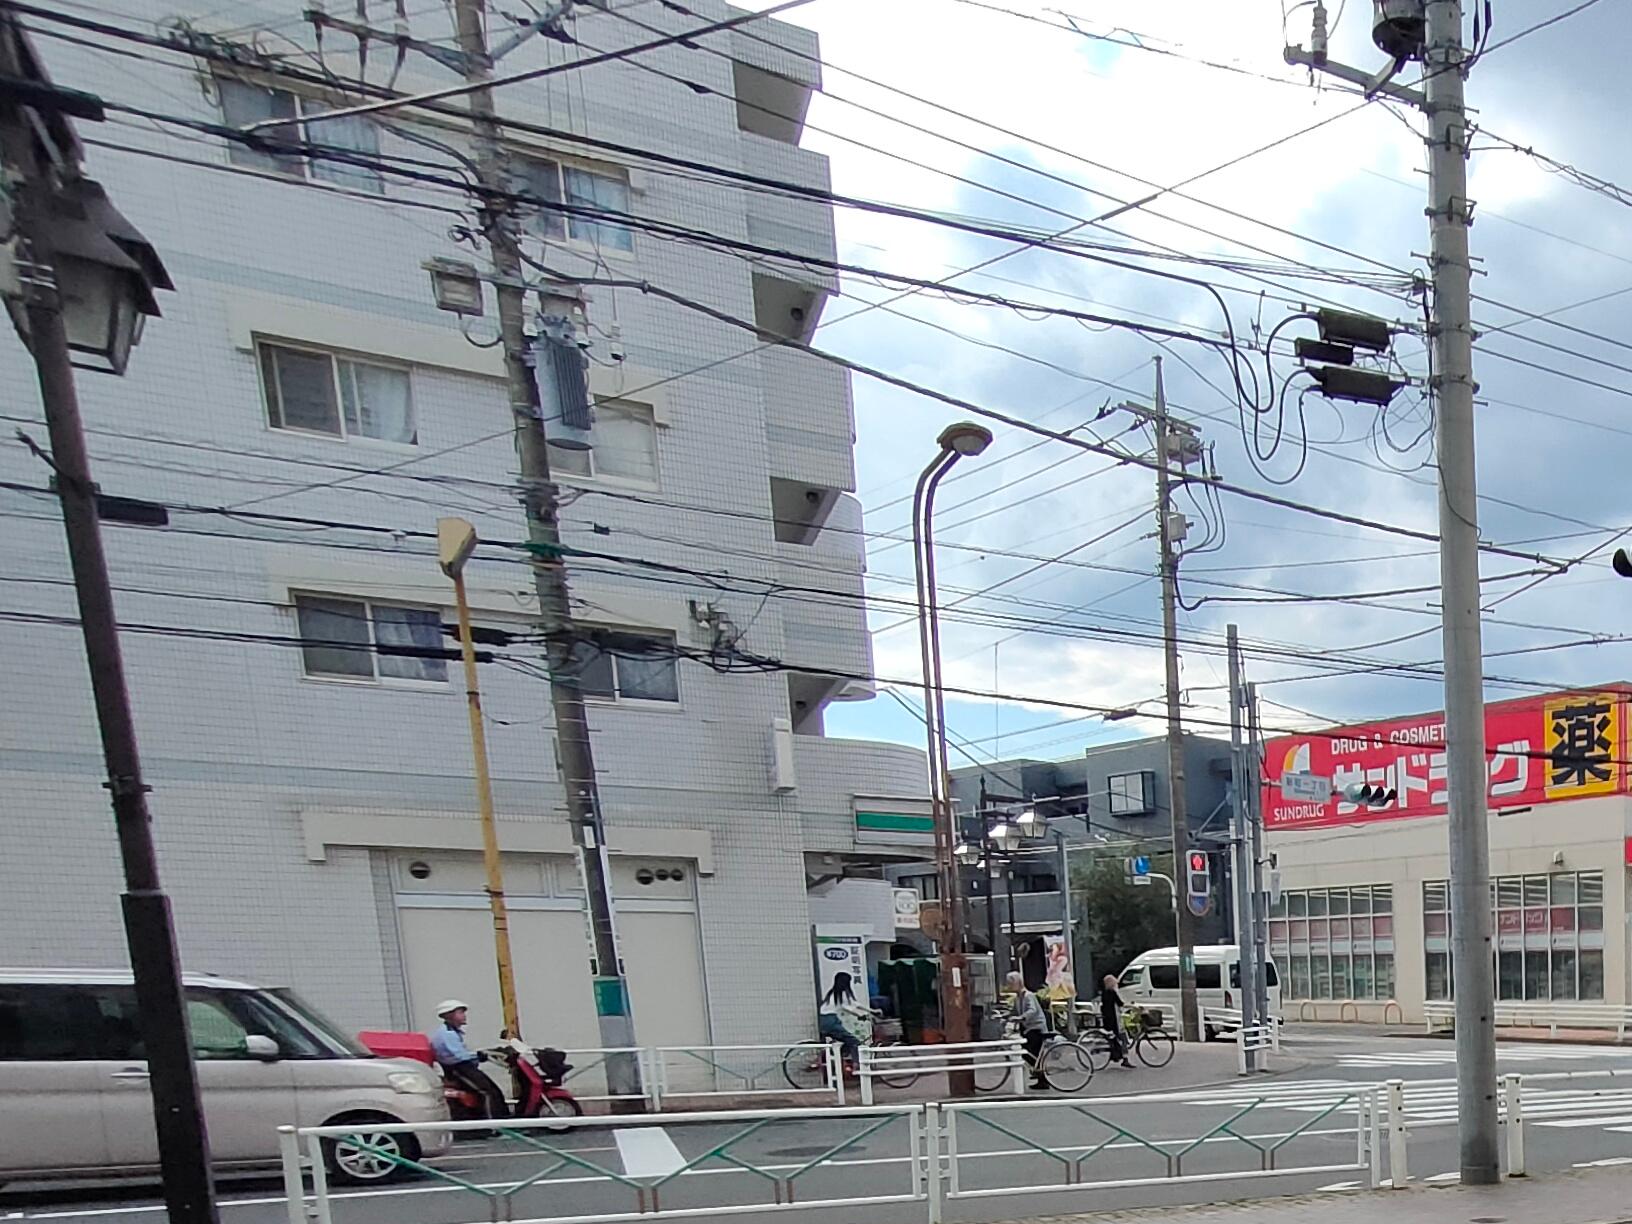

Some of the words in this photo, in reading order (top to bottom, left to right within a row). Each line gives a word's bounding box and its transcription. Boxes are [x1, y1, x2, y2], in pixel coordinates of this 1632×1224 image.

[1332, 737, 1368, 755] DRUG
[1551, 702, 1612, 785] 薬
[1274, 803, 1325, 821] SUNDRUG
